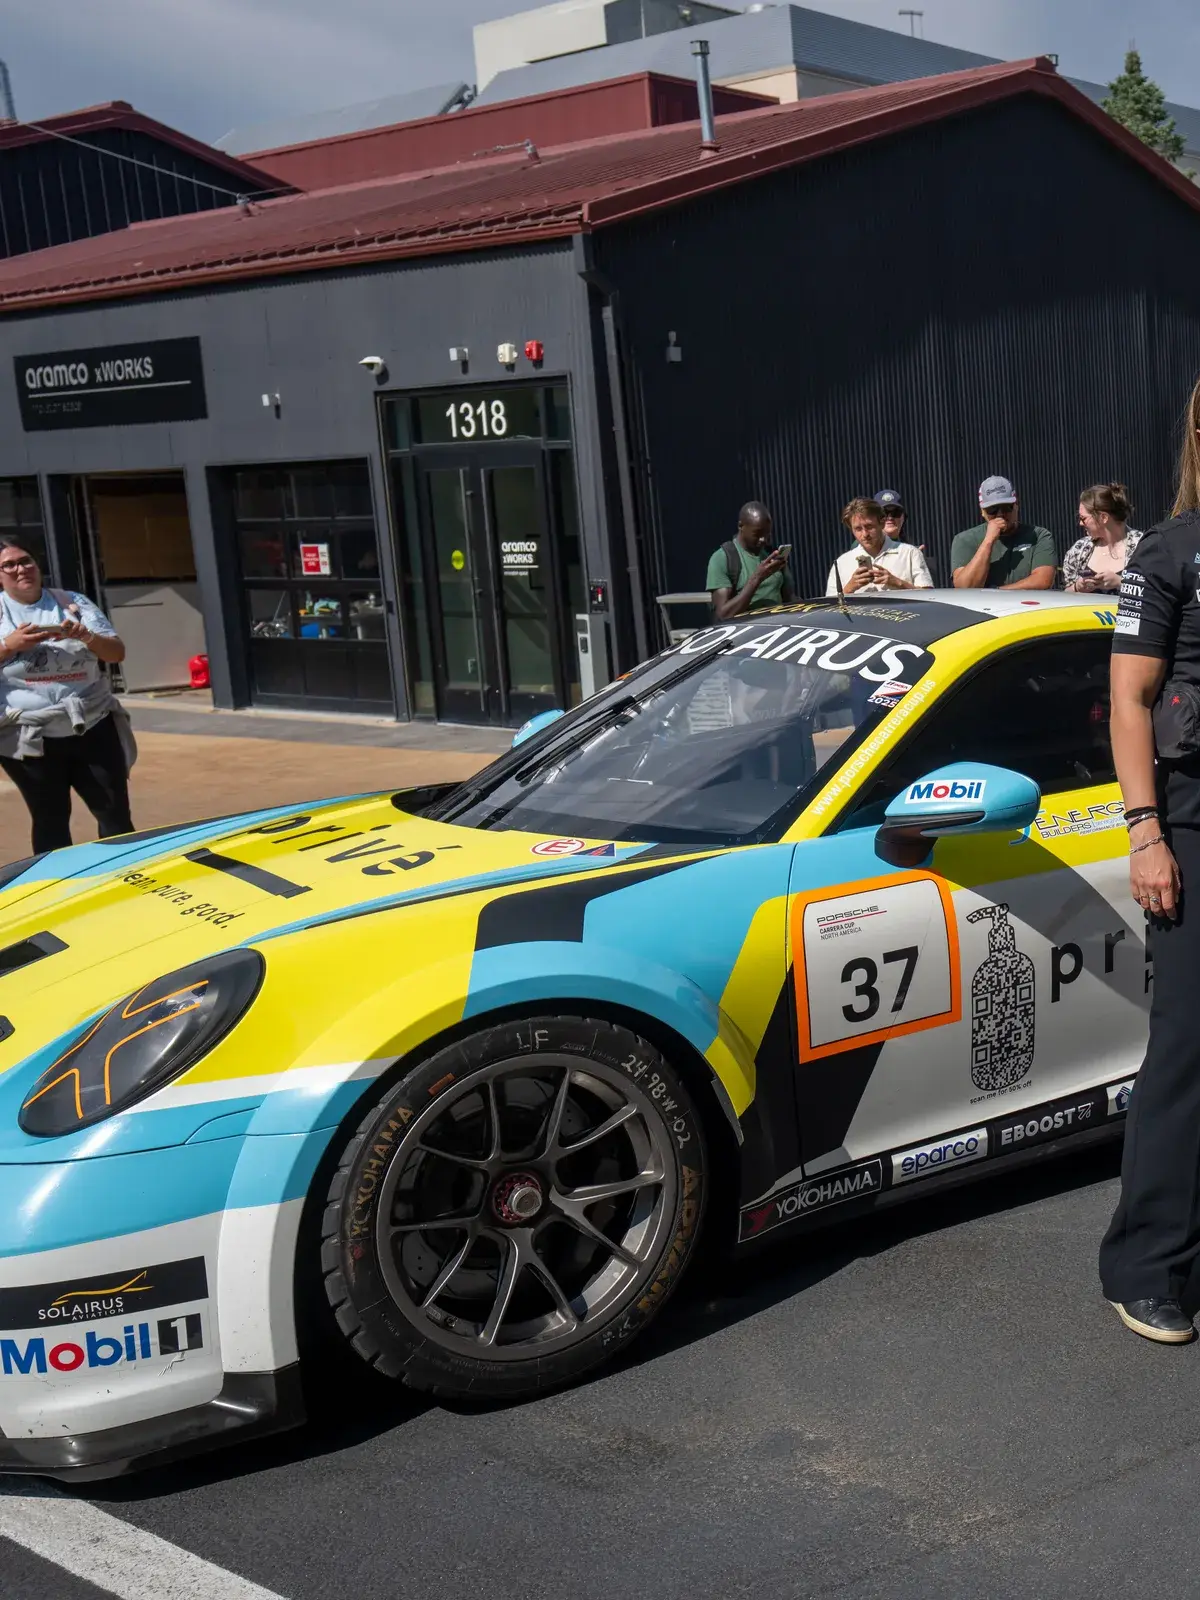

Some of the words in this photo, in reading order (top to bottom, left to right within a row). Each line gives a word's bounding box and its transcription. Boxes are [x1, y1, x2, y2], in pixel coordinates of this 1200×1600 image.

[25, 362, 89, 389] aramco
[94, 356, 154, 384] xWORKS
[445, 399, 507, 438] 1318
[501, 541, 537, 552] aramco
[660, 625, 926, 682] SOLAIRUS
[867, 695, 899, 708] 2025
[811, 679, 937, 817] www.porschecarreracup.us
[910, 782, 982, 800] Mobil
[1041, 822, 1092, 839] BUILDERS
[217, 815, 463, 877] privé
[142, 884, 193, 906] pure.
[816, 905, 879, 924] PORSCHE
[819, 924, 844, 935] CARRERA
[844, 922, 855, 930] CUP
[820, 932, 839, 941] NORTH
[839, 927, 862, 937] AMERICA
[841, 945, 919, 1023] 37
[516, 1029, 549, 1050] LF
[970, 1095, 985, 1104] scan
[1008, 1084, 1021, 1093] 50%
[1022, 1080, 1032, 1089] off
[1001, 1107, 1076, 1146] EBOOST
[901, 1137, 979, 1175] sparco
[775, 1170, 875, 1219] YOKOHAMA
[38, 1296, 125, 1320] SOLAIRUS
[72, 1308, 125, 1321] AVIATION
[0, 1322, 152, 1375] Mobil
[170, 1316, 190, 1351] 1
